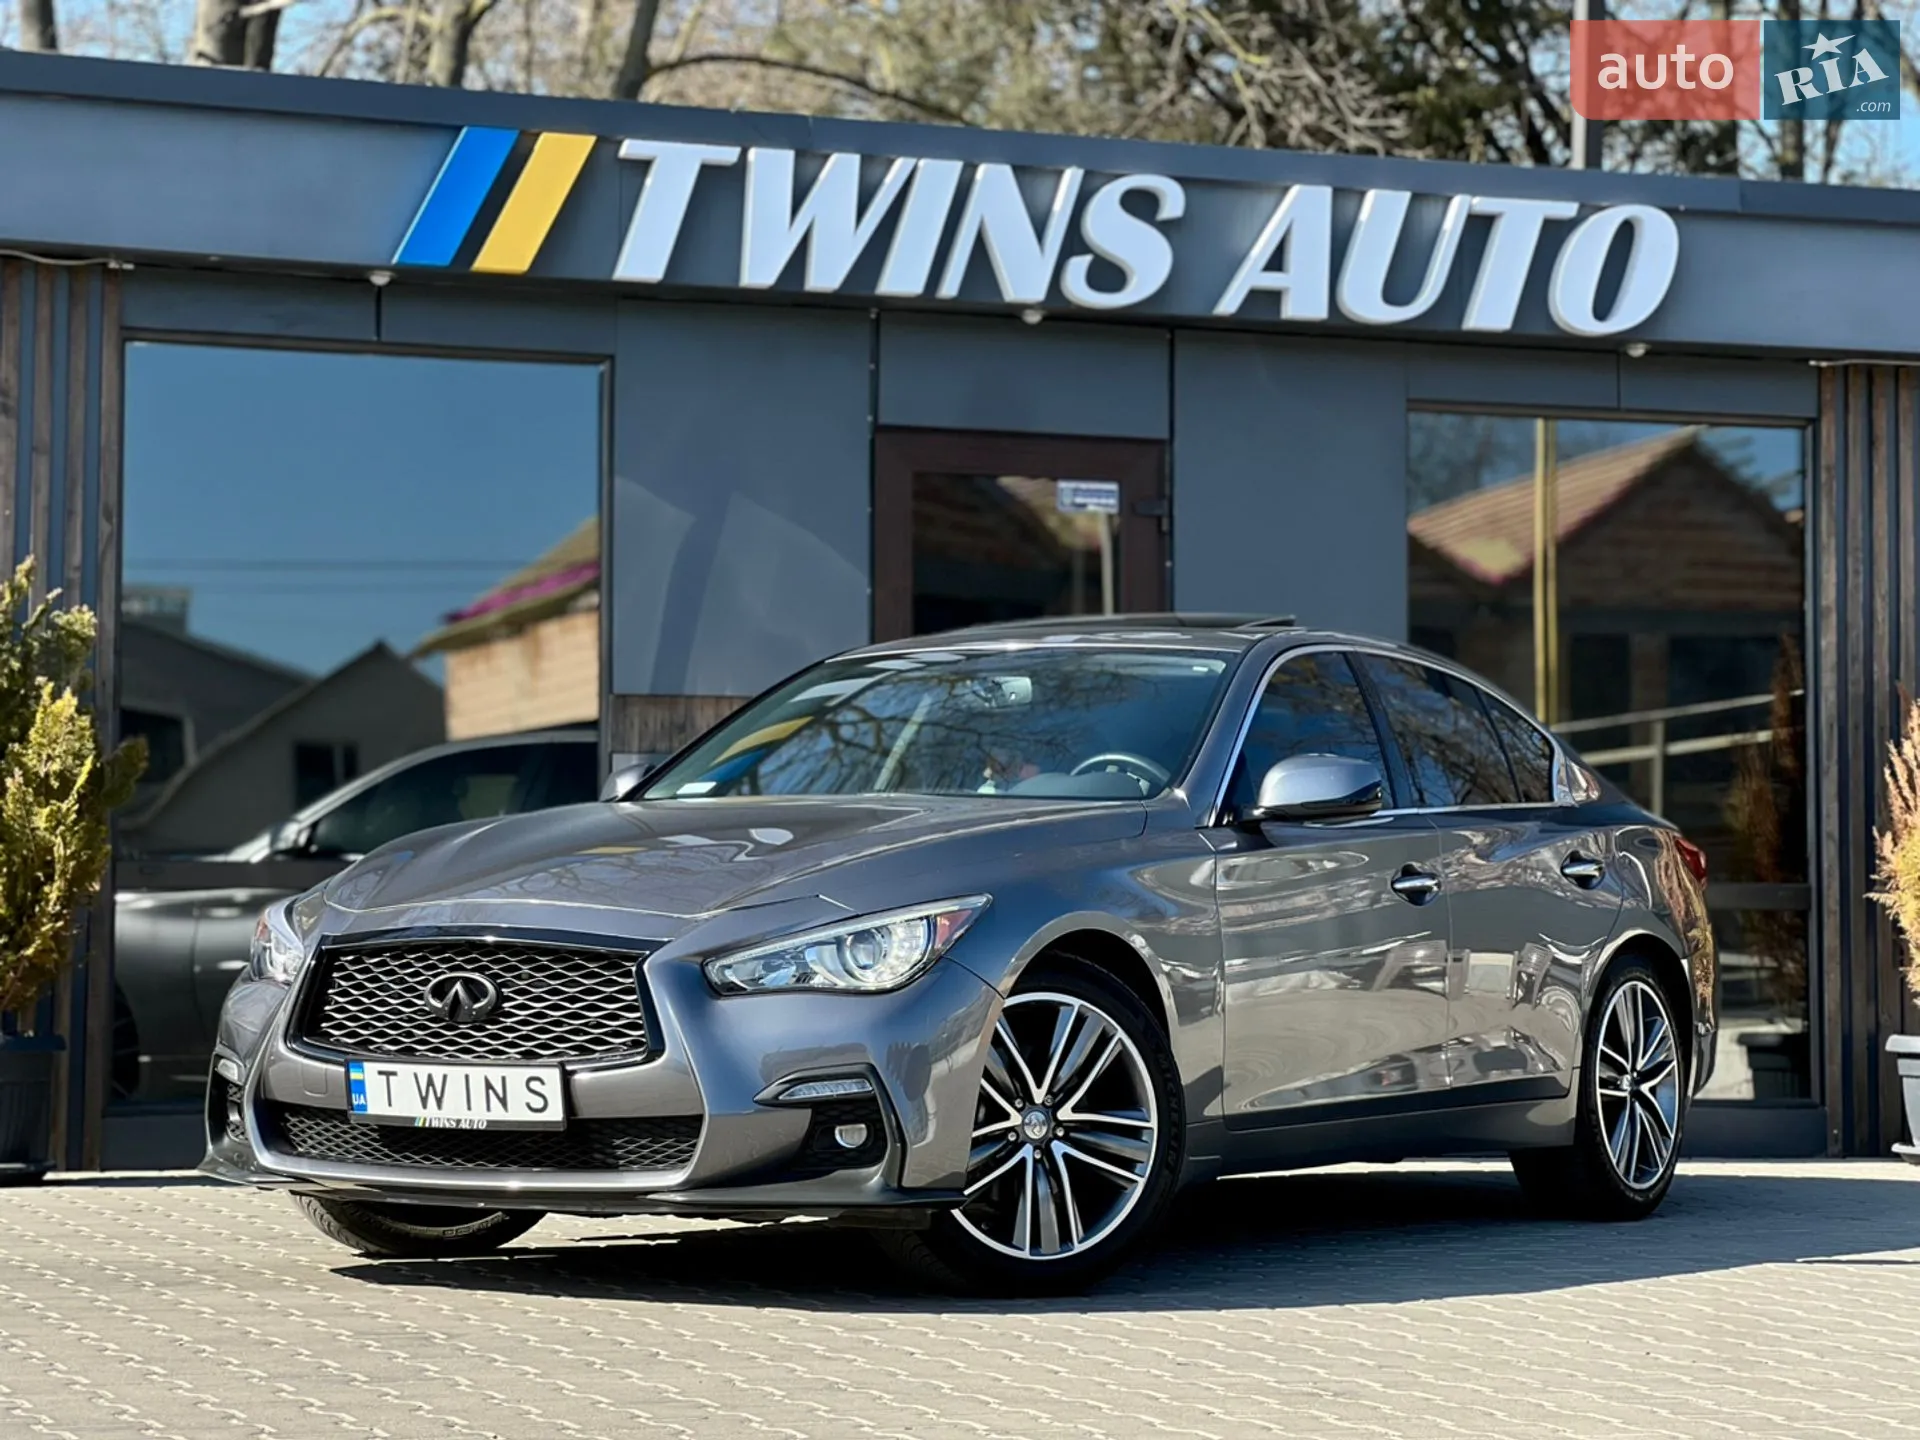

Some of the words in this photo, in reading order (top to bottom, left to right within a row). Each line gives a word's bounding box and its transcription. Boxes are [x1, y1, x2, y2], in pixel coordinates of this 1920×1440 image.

[612, 138, 1186, 309] TWINS
[1212, 184, 1680, 336] AUTO
[352, 1093, 367, 1105] UA
[377, 1070, 549, 1113] TWINS
[1156, 1053, 1180, 1167] MICHELIN
[425, 1117, 457, 1129] TWINS
[458, 1118, 488, 1130] AUTO
